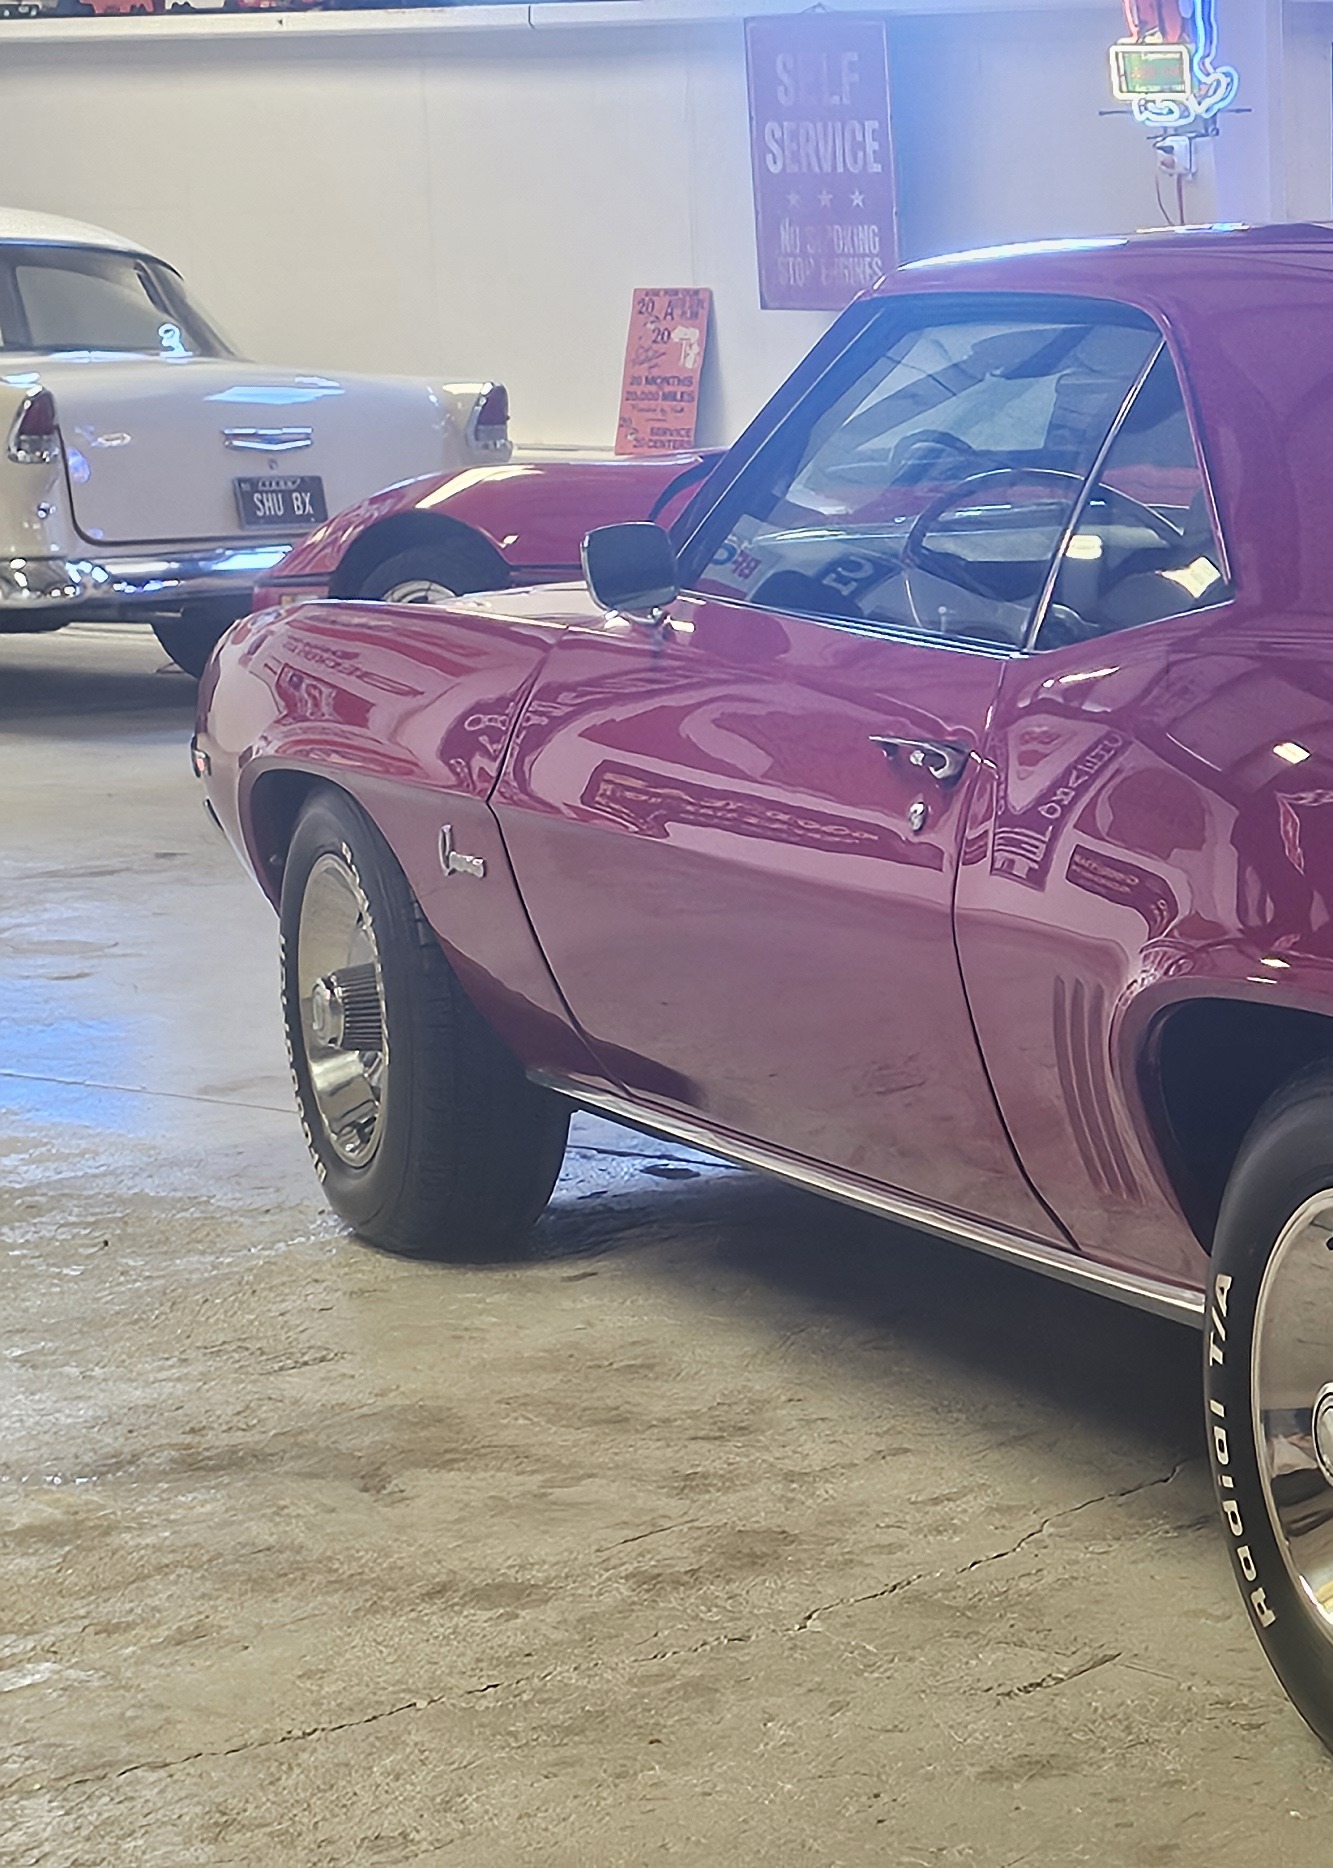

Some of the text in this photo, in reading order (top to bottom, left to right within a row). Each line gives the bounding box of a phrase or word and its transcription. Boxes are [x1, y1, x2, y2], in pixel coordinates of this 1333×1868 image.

[763, 119, 883, 175] SERVICE
[652, 327, 671, 344] 20
[253, 491, 314, 516] SHU BX
[1209, 1273, 1276, 1628] Radial T/A
